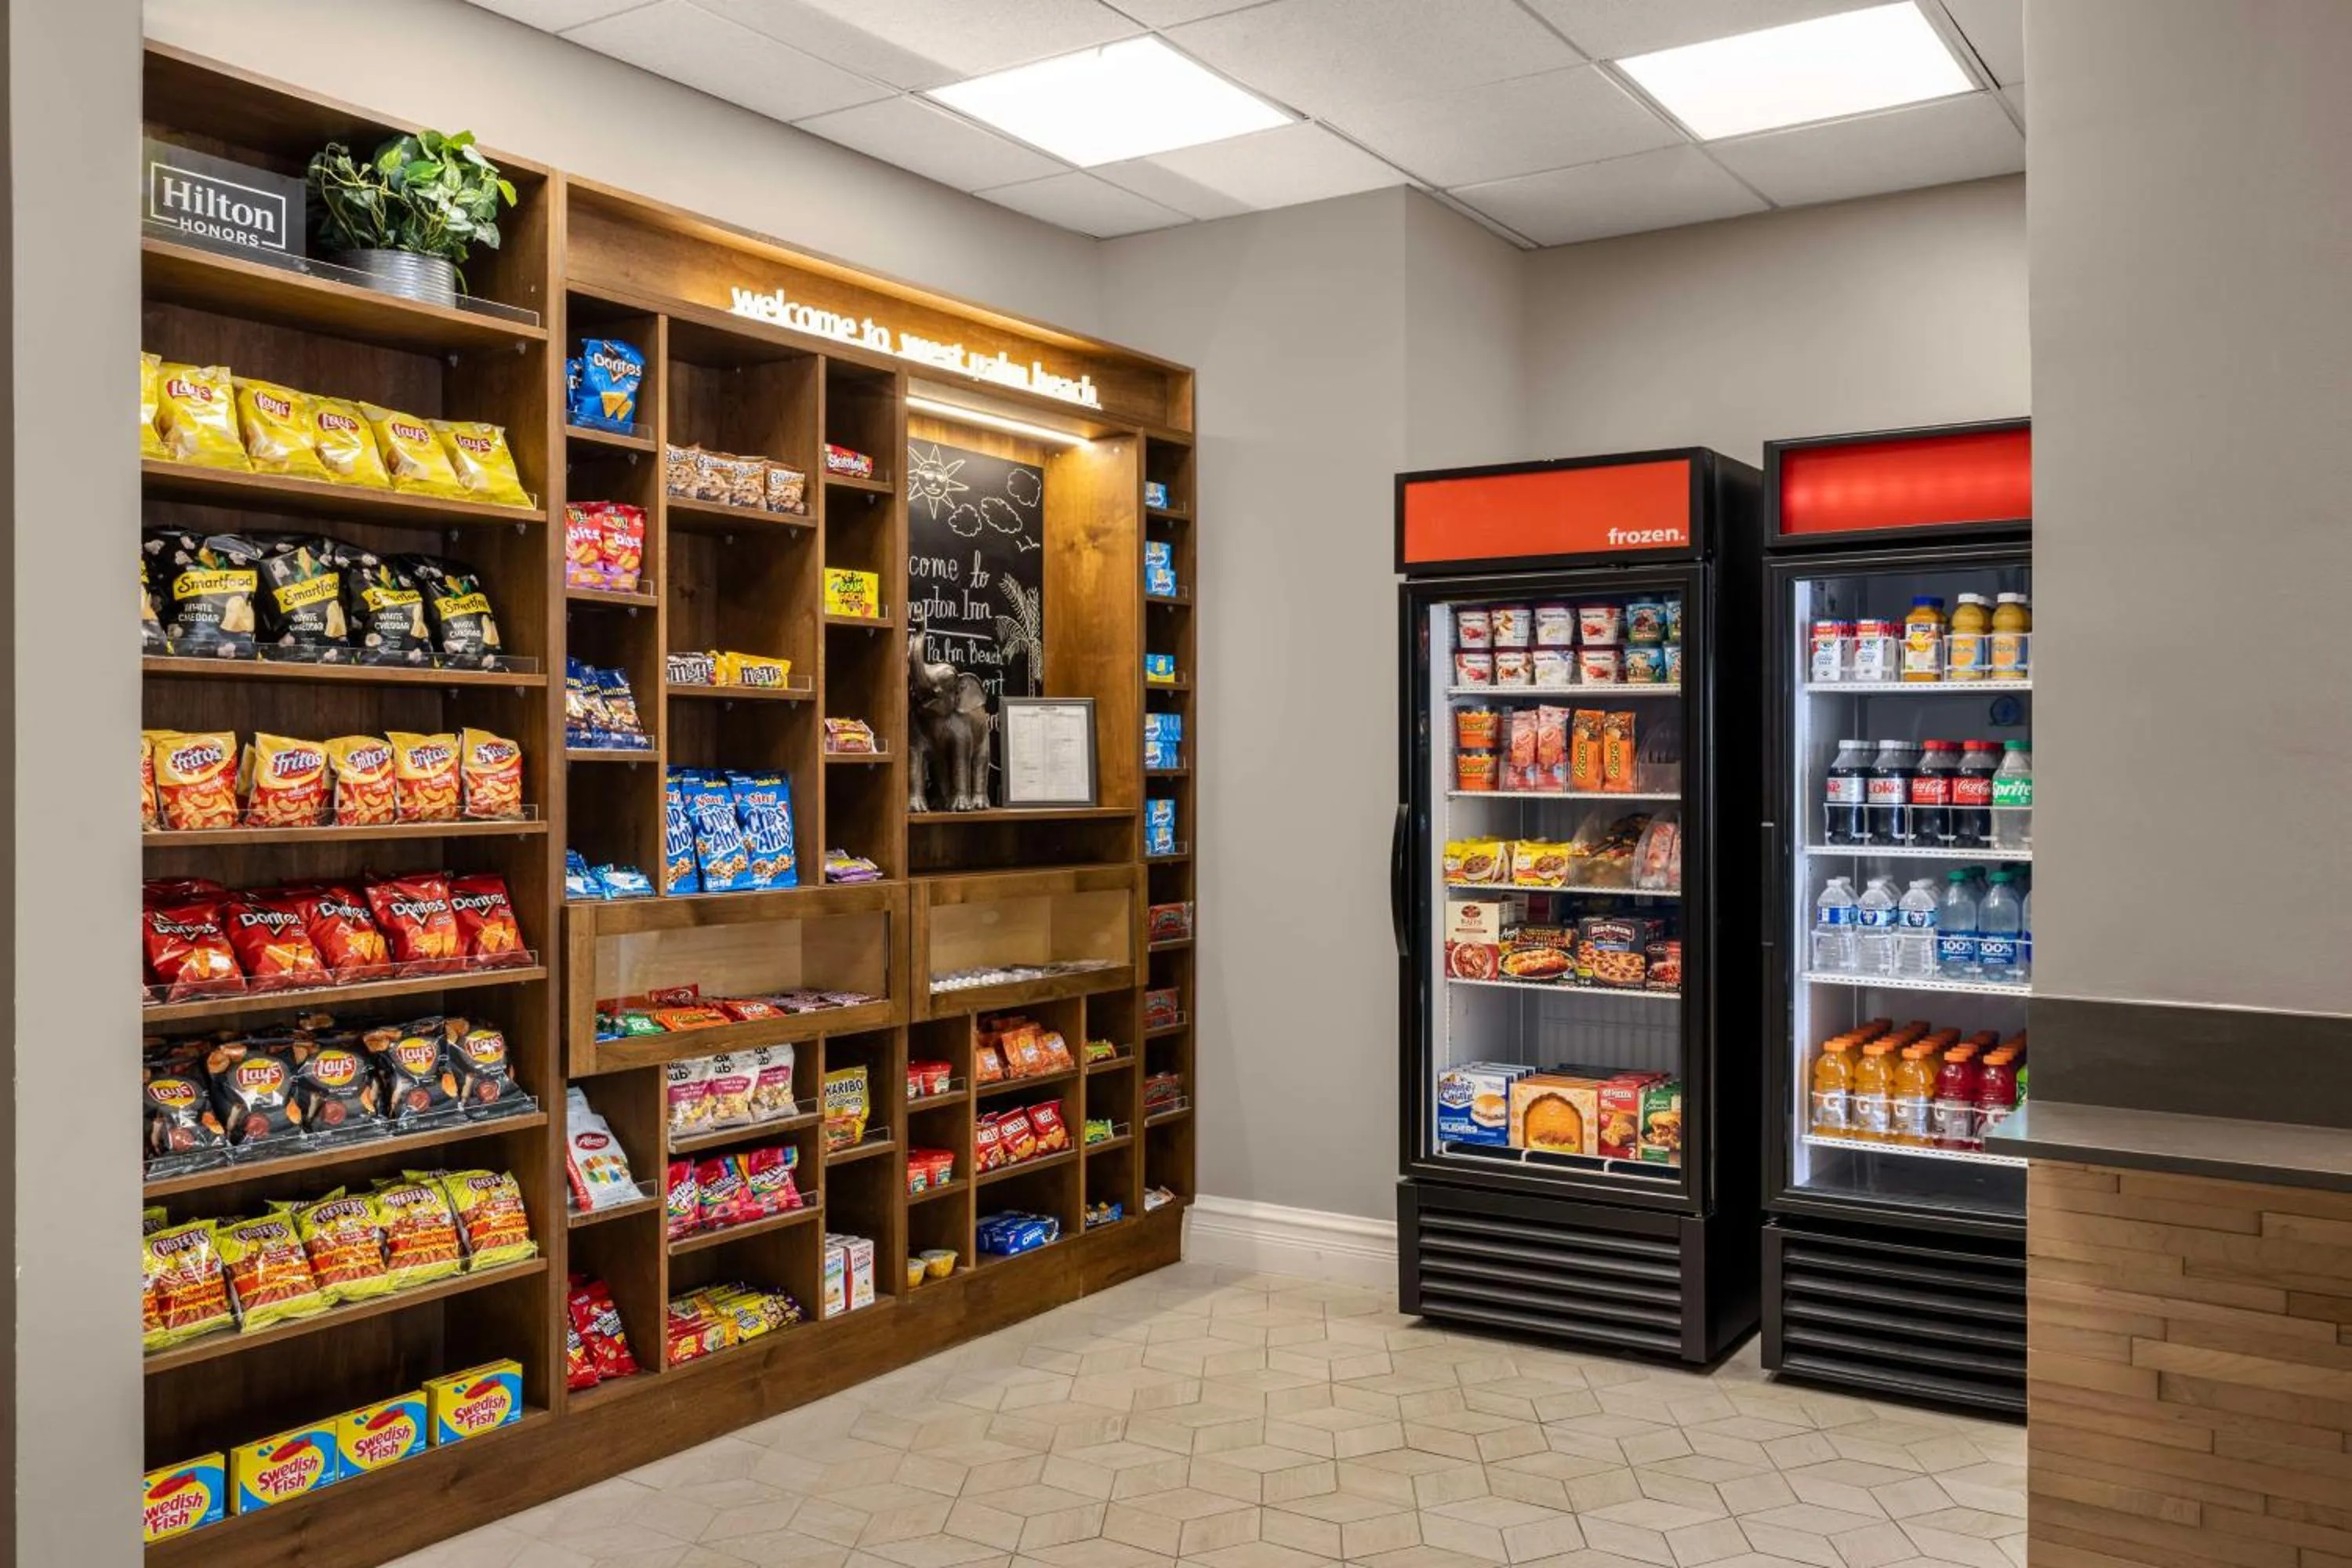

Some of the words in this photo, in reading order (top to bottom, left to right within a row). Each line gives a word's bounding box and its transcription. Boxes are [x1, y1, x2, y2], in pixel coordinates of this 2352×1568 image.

[162, 176, 276, 233] Hilton
[180, 216, 260, 247] HONORS
[731, 287, 857, 339] welcome
[862, 318, 891, 350] to
[900, 332, 966, 365] west
[1607, 527, 1686, 546] frozen.
[909, 555, 959, 581] come
[970, 550, 990, 588] to
[178, 574, 252, 593] Smartfood
[283, 579, 339, 605] Smartfoo
[184, 603, 213, 613] WHITE
[962, 589, 992, 620] Inn
[178, 613, 220, 623] CHEDDAR
[171, 746, 222, 773] Fritos
[272, 750, 322, 775] Fritos
[390, 898, 448, 916] Doritos
[1942, 940, 1973, 951] 100%
[1980, 942, 2013, 953] 100%
[401, 1045, 433, 1063] Lay's
[242, 1065, 281, 1084] Lay's
[317, 1058, 353, 1078] Lay's
[154, 1083, 191, 1100] Lay's
[825, 1079, 864, 1096] HARIBO
[453, 1395, 507, 1425] Swedish
[466, 1410, 496, 1430] Fish
[354, 1425, 412, 1458] Swedish
[368, 1442, 399, 1463] Fish
[258, 1456, 319, 1491] Swedish
[273, 1474, 307, 1495] Fish
[151, 1510, 190, 1534] Fish
